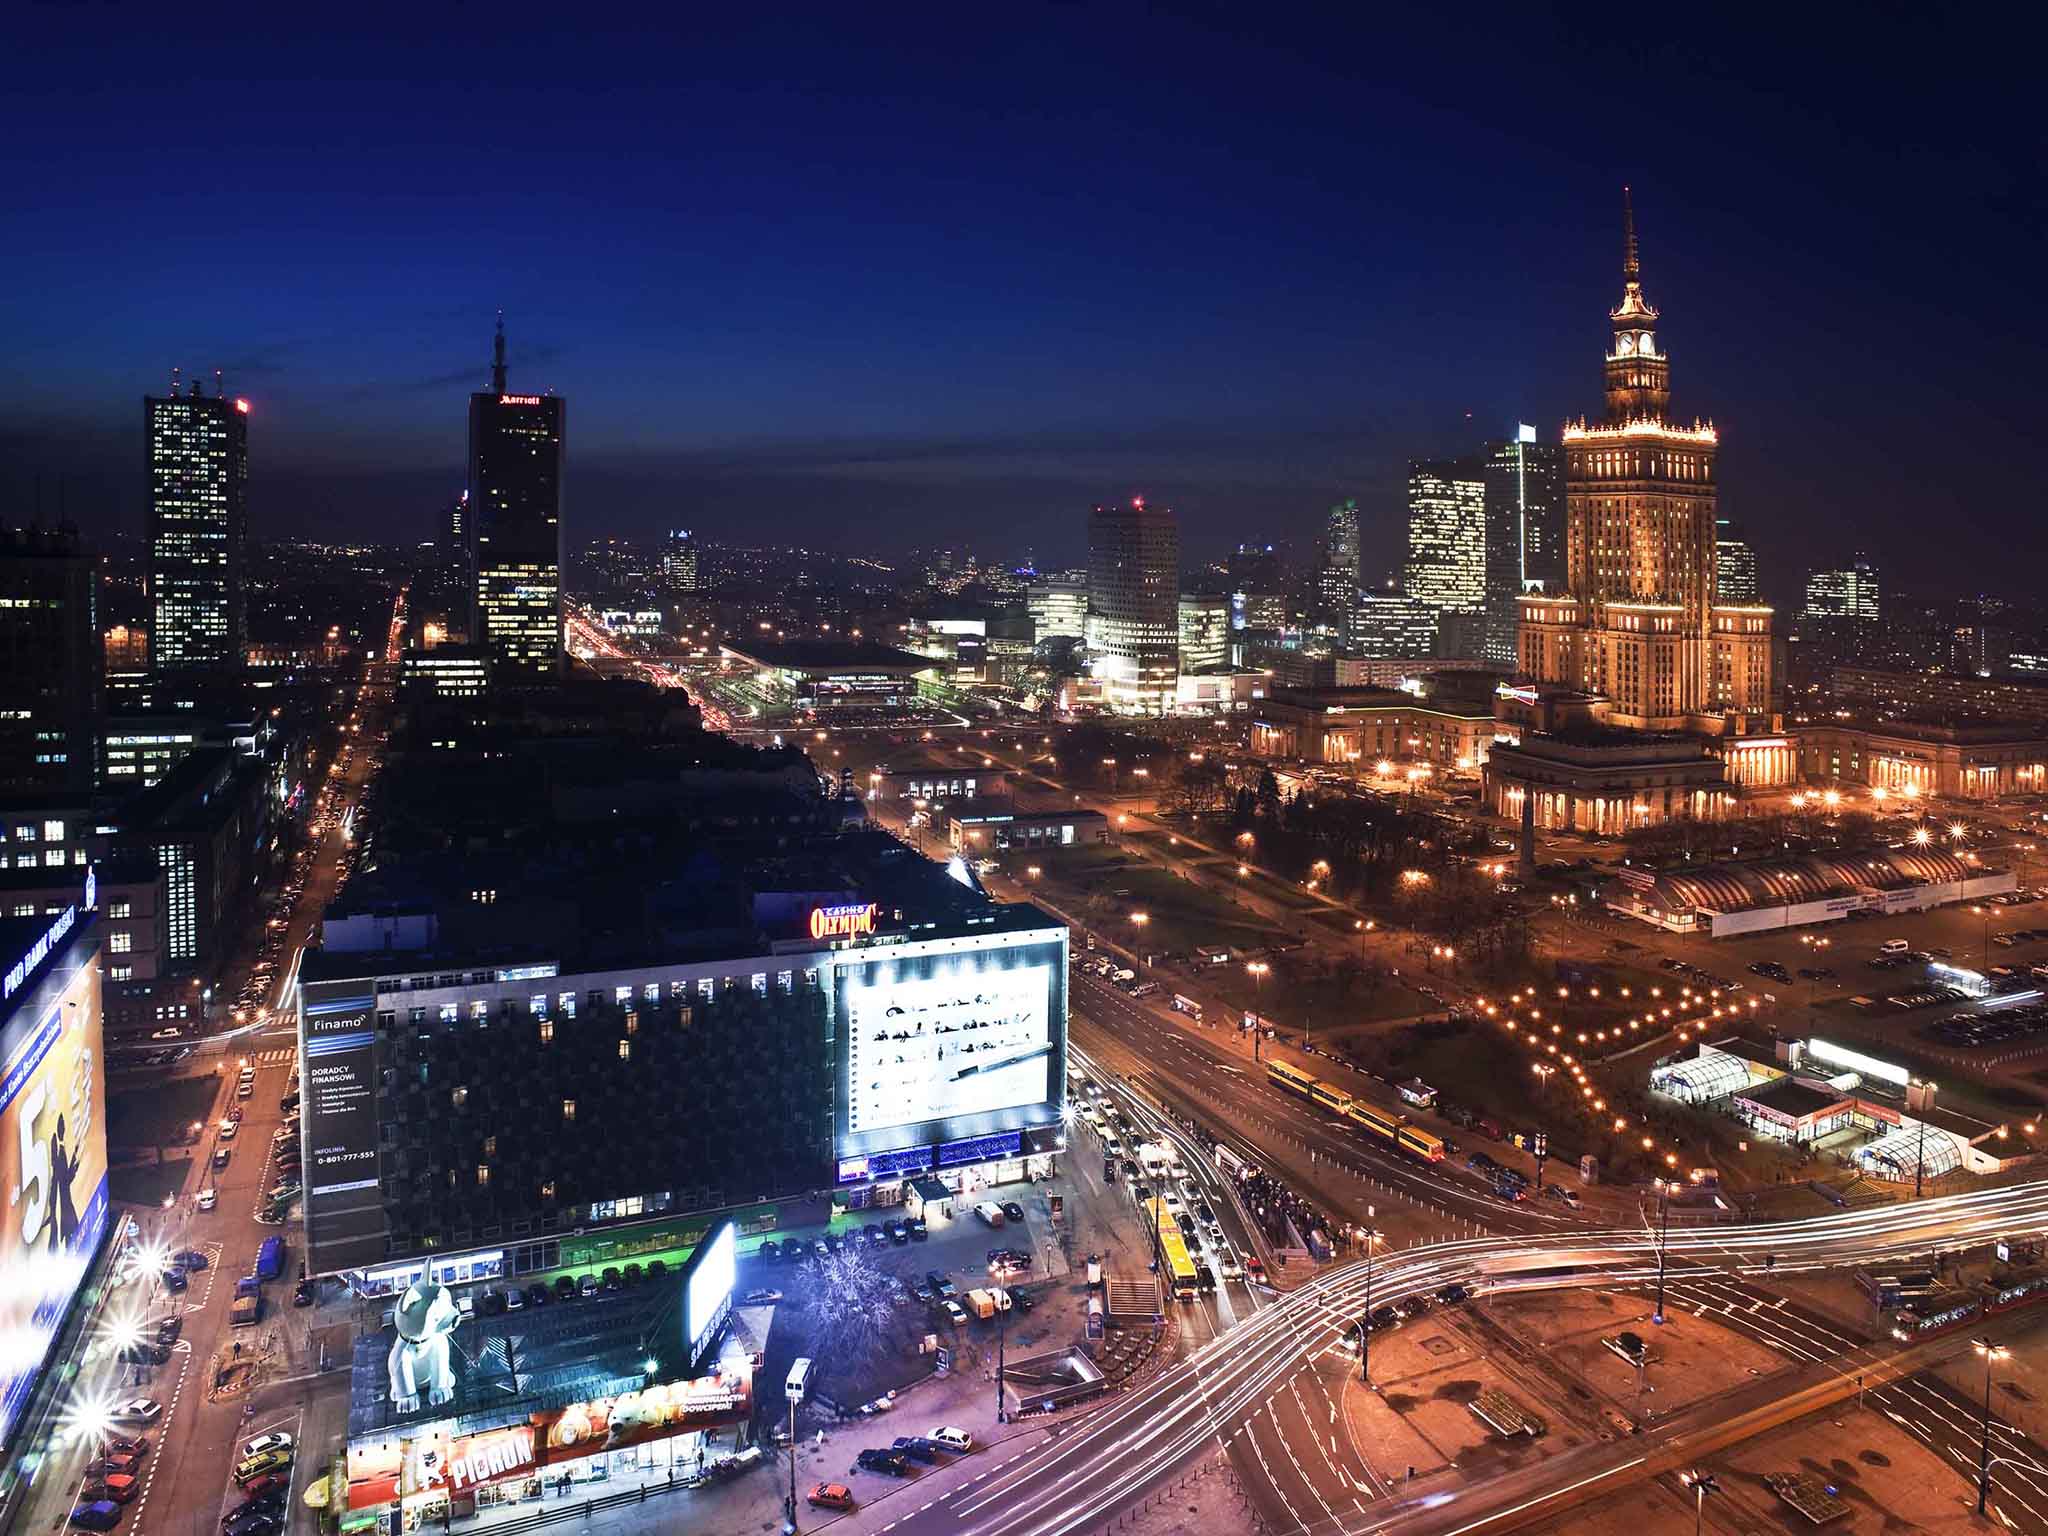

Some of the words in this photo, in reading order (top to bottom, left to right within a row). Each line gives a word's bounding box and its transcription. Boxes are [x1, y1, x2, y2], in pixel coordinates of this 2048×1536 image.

[500, 395, 540, 405] Marriott
[826, 905, 865, 916] CASINO
[4, 961, 24, 999] PKO
[25, 933, 48, 977] BANK
[49, 904, 75, 949] POLSKI
[314, 1019, 361, 1031] finamo
[311, 1065, 349, 1077] DORADCY
[311, 1073, 355, 1085] FINANSOWI
[317, 1151, 375, 1165] 0-801-777-555
